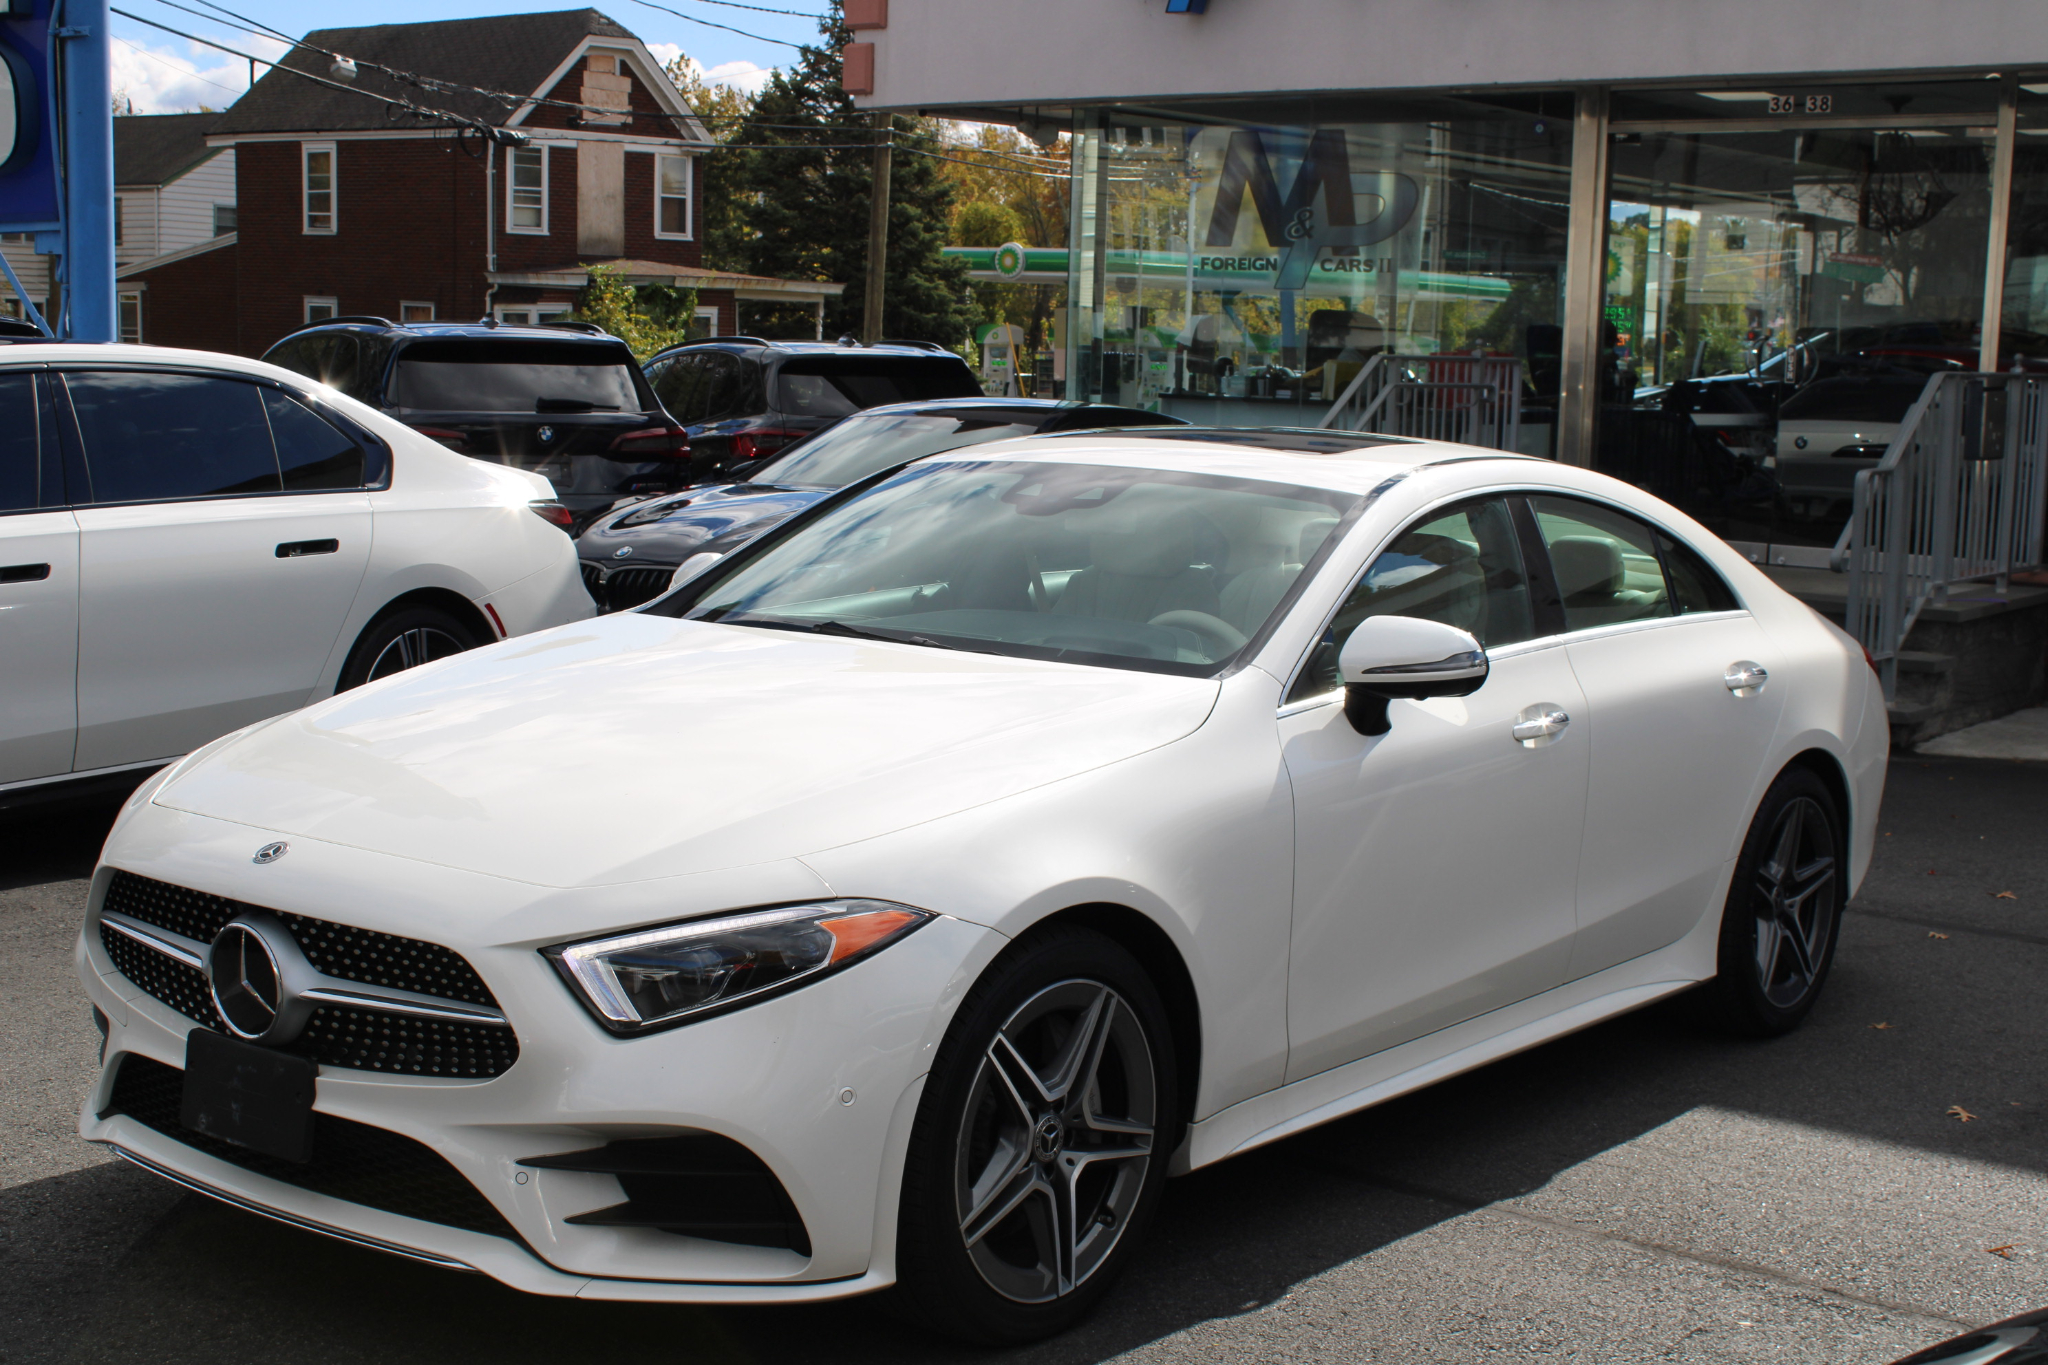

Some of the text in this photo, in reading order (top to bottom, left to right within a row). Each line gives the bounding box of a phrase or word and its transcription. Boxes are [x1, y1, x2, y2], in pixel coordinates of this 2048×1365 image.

[1200, 257, 1278, 271] FOREIGN
[1320, 258, 1374, 273] CARS
[1786, 346, 1795, 380] PUSH
